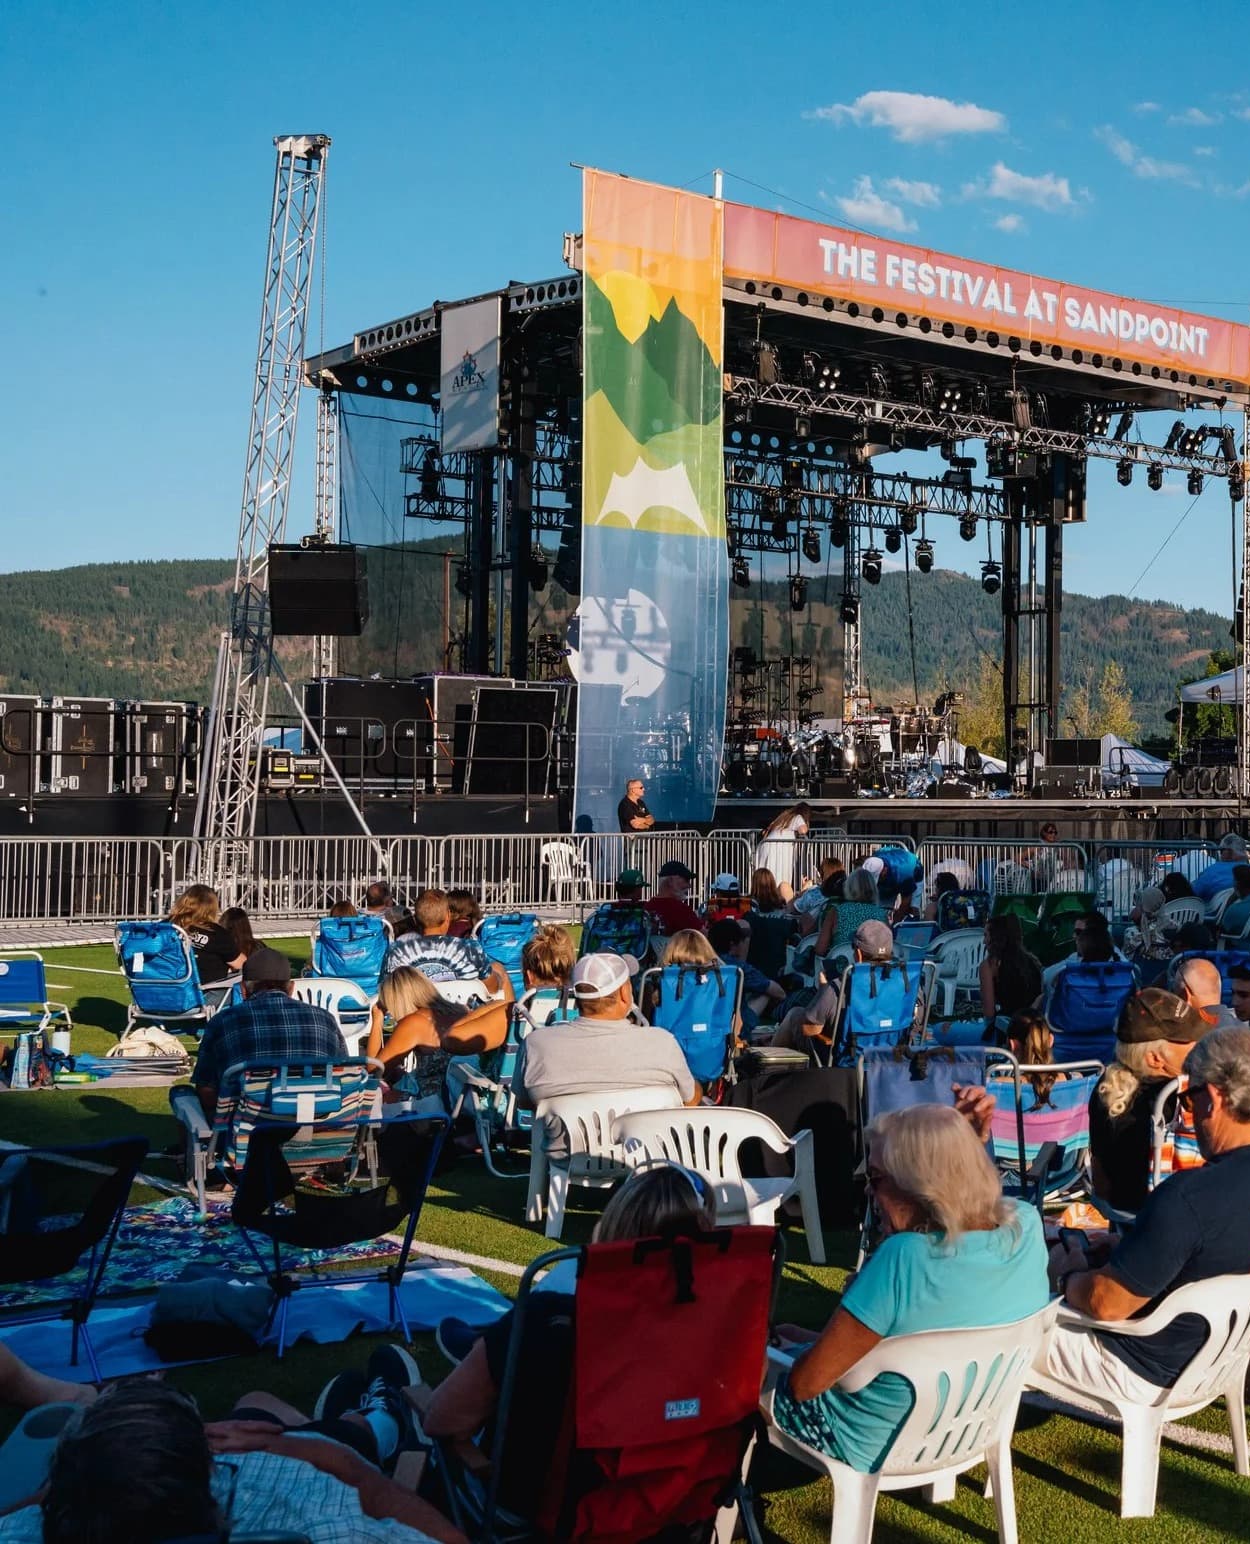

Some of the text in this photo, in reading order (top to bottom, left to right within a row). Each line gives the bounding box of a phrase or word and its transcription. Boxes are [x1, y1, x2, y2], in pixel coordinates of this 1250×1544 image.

[819, 238, 1209, 356] THE FESTIVAL AT SANDPOINT
[453, 371, 487, 387] APEX
